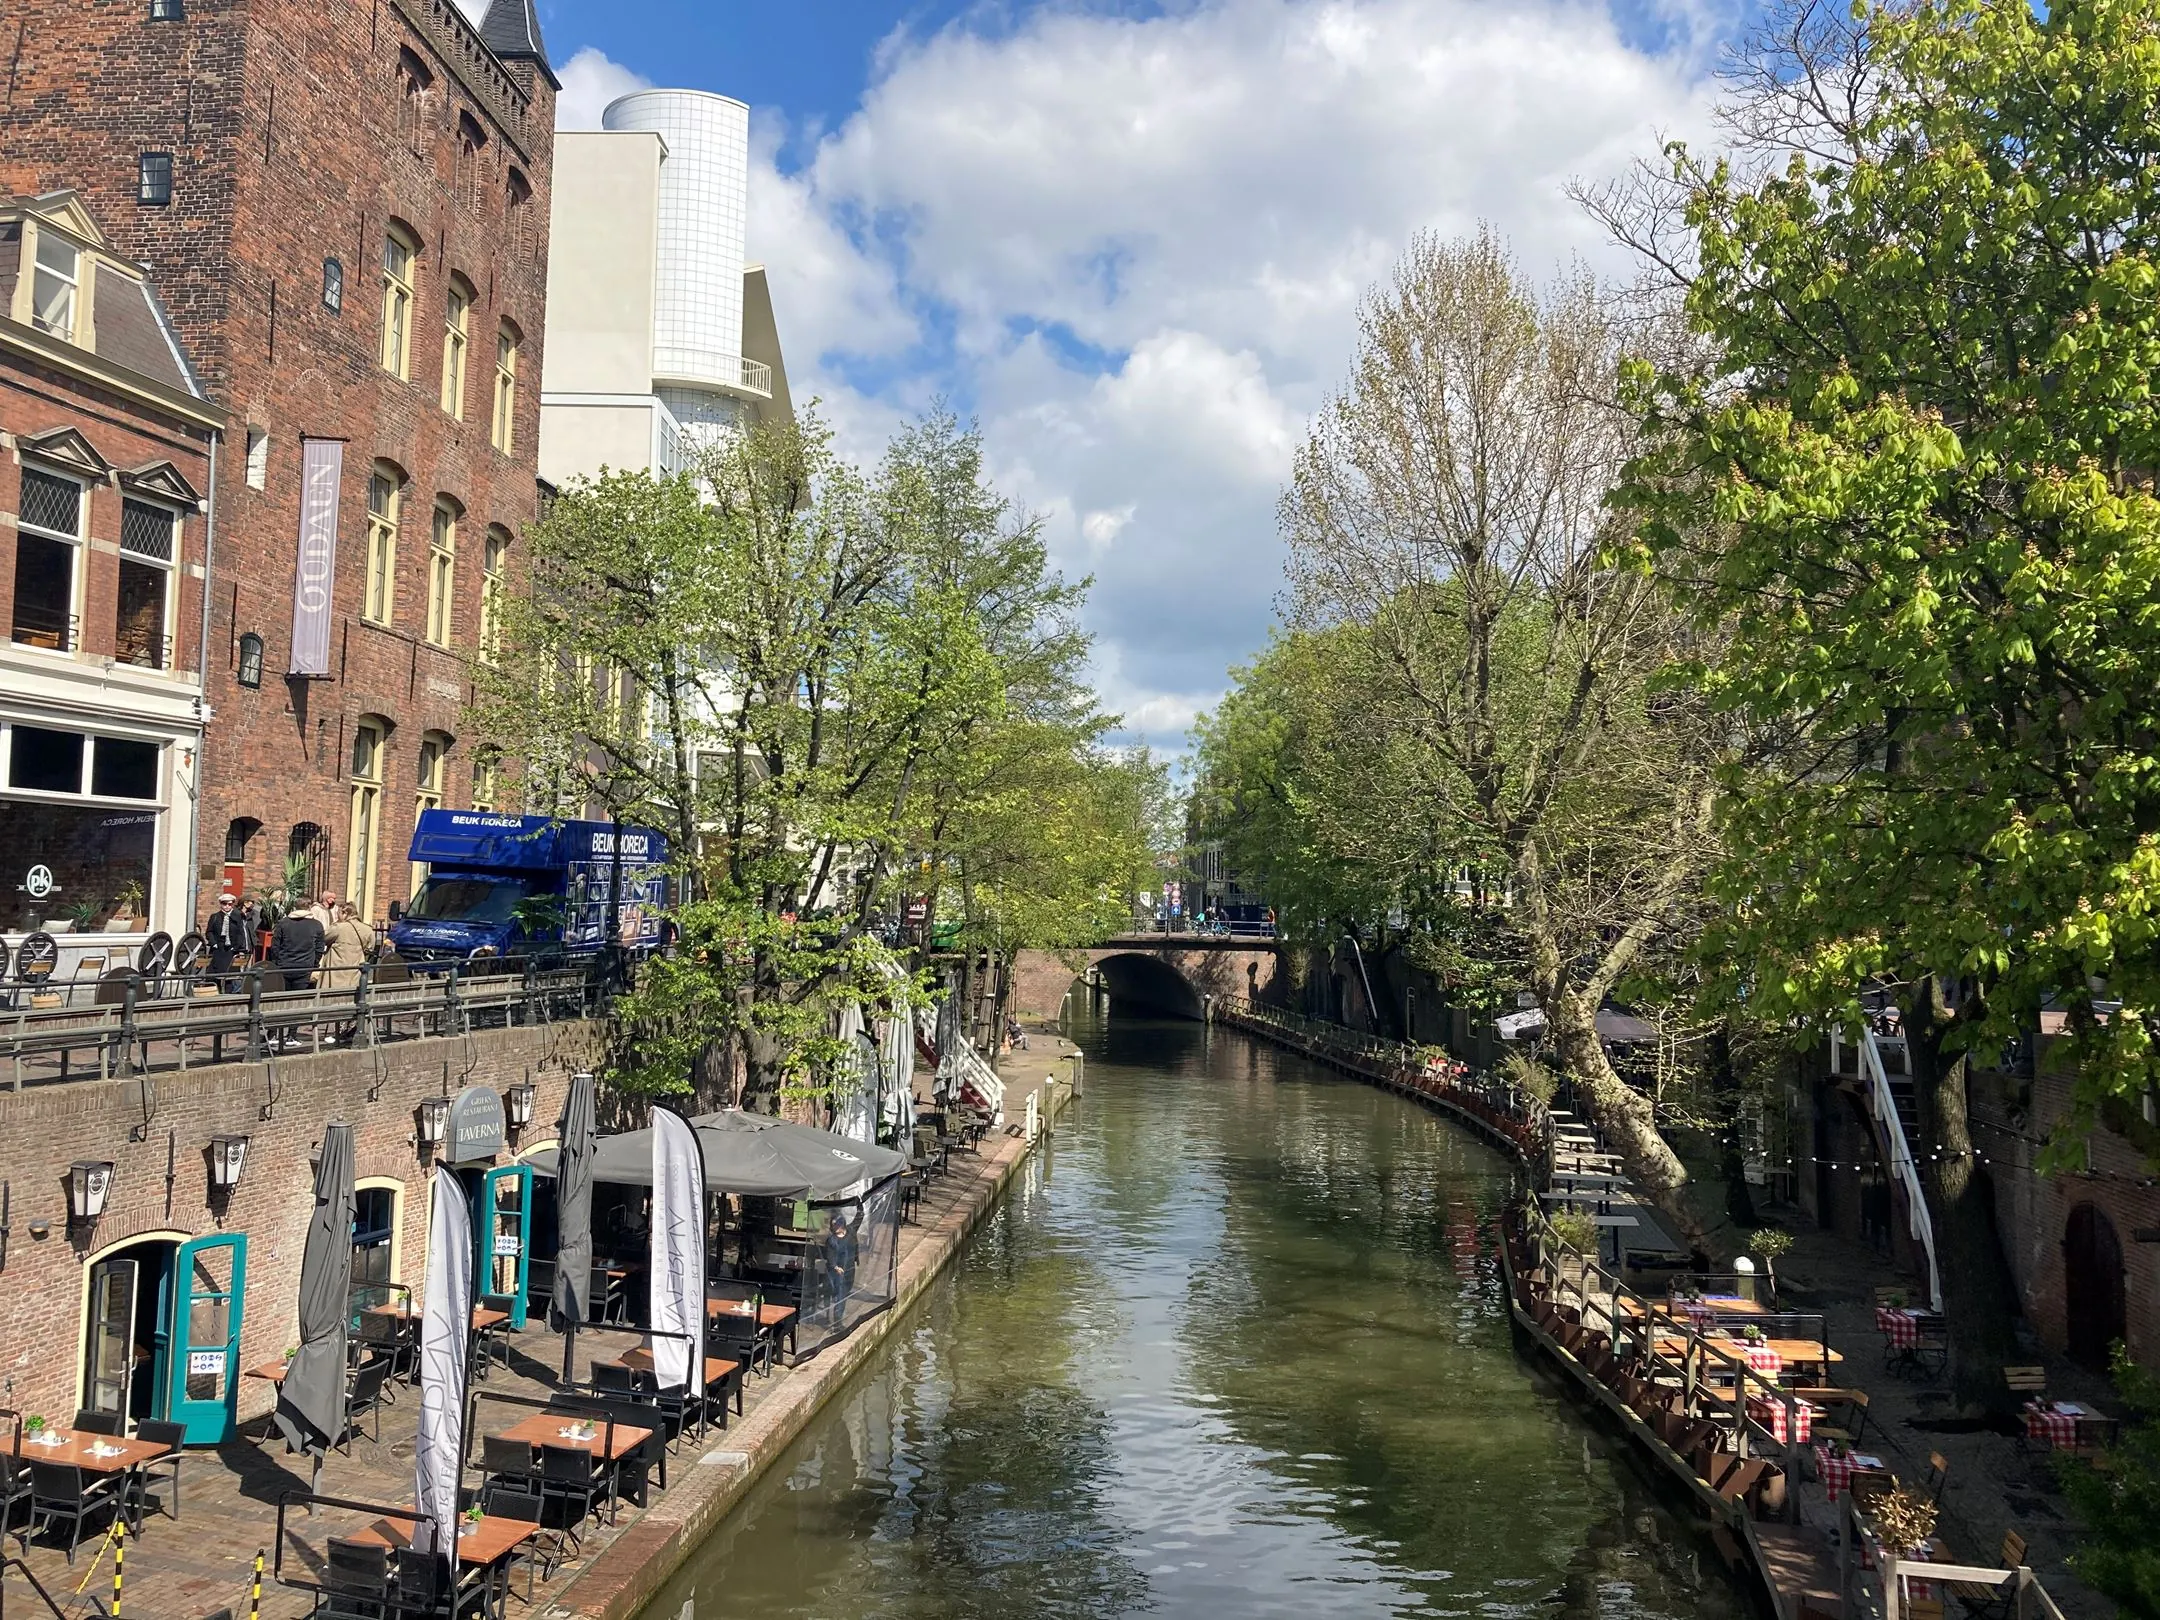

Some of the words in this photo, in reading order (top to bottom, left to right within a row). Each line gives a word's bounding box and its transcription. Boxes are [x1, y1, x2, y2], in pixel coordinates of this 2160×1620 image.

[298, 464, 335, 613] OUDAEN
[451, 815, 479, 825] BEUK
[480, 817, 522, 828] HORECA
[591, 832, 616, 853] BEUK
[31, 868, 49, 892] pk
[463, 1103, 498, 1116] RESTAURANT
[459, 1121, 500, 1142] TAVERNA
